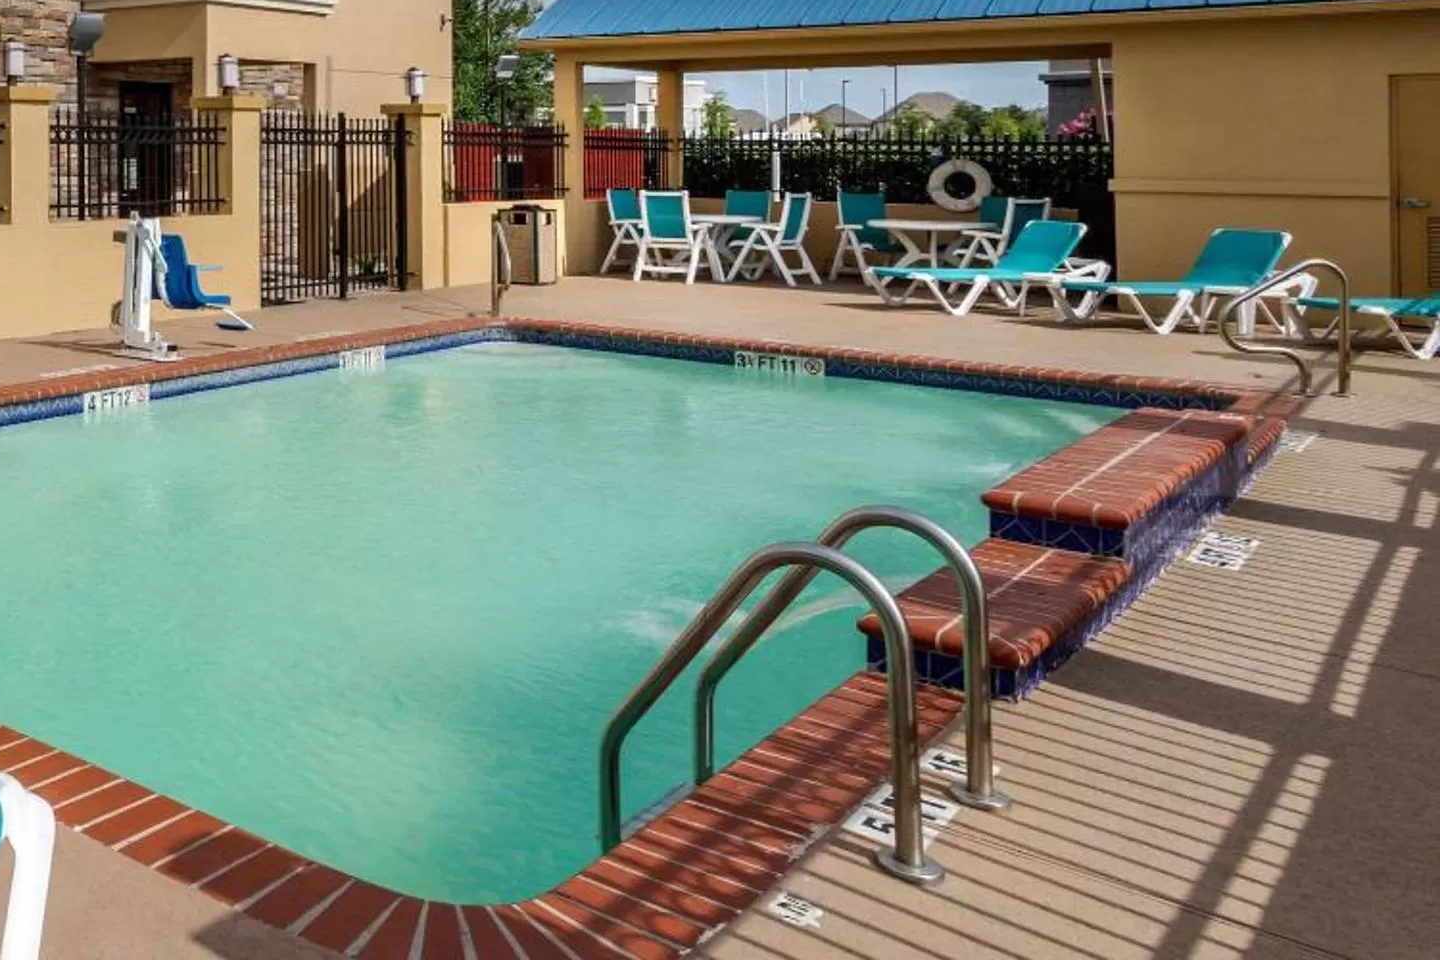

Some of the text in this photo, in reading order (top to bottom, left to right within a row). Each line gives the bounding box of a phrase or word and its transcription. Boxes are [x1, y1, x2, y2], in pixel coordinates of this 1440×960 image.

[758, 355, 777, 371] FT
[88, 394, 96, 410] 4
[101, 391, 116, 409] FT
